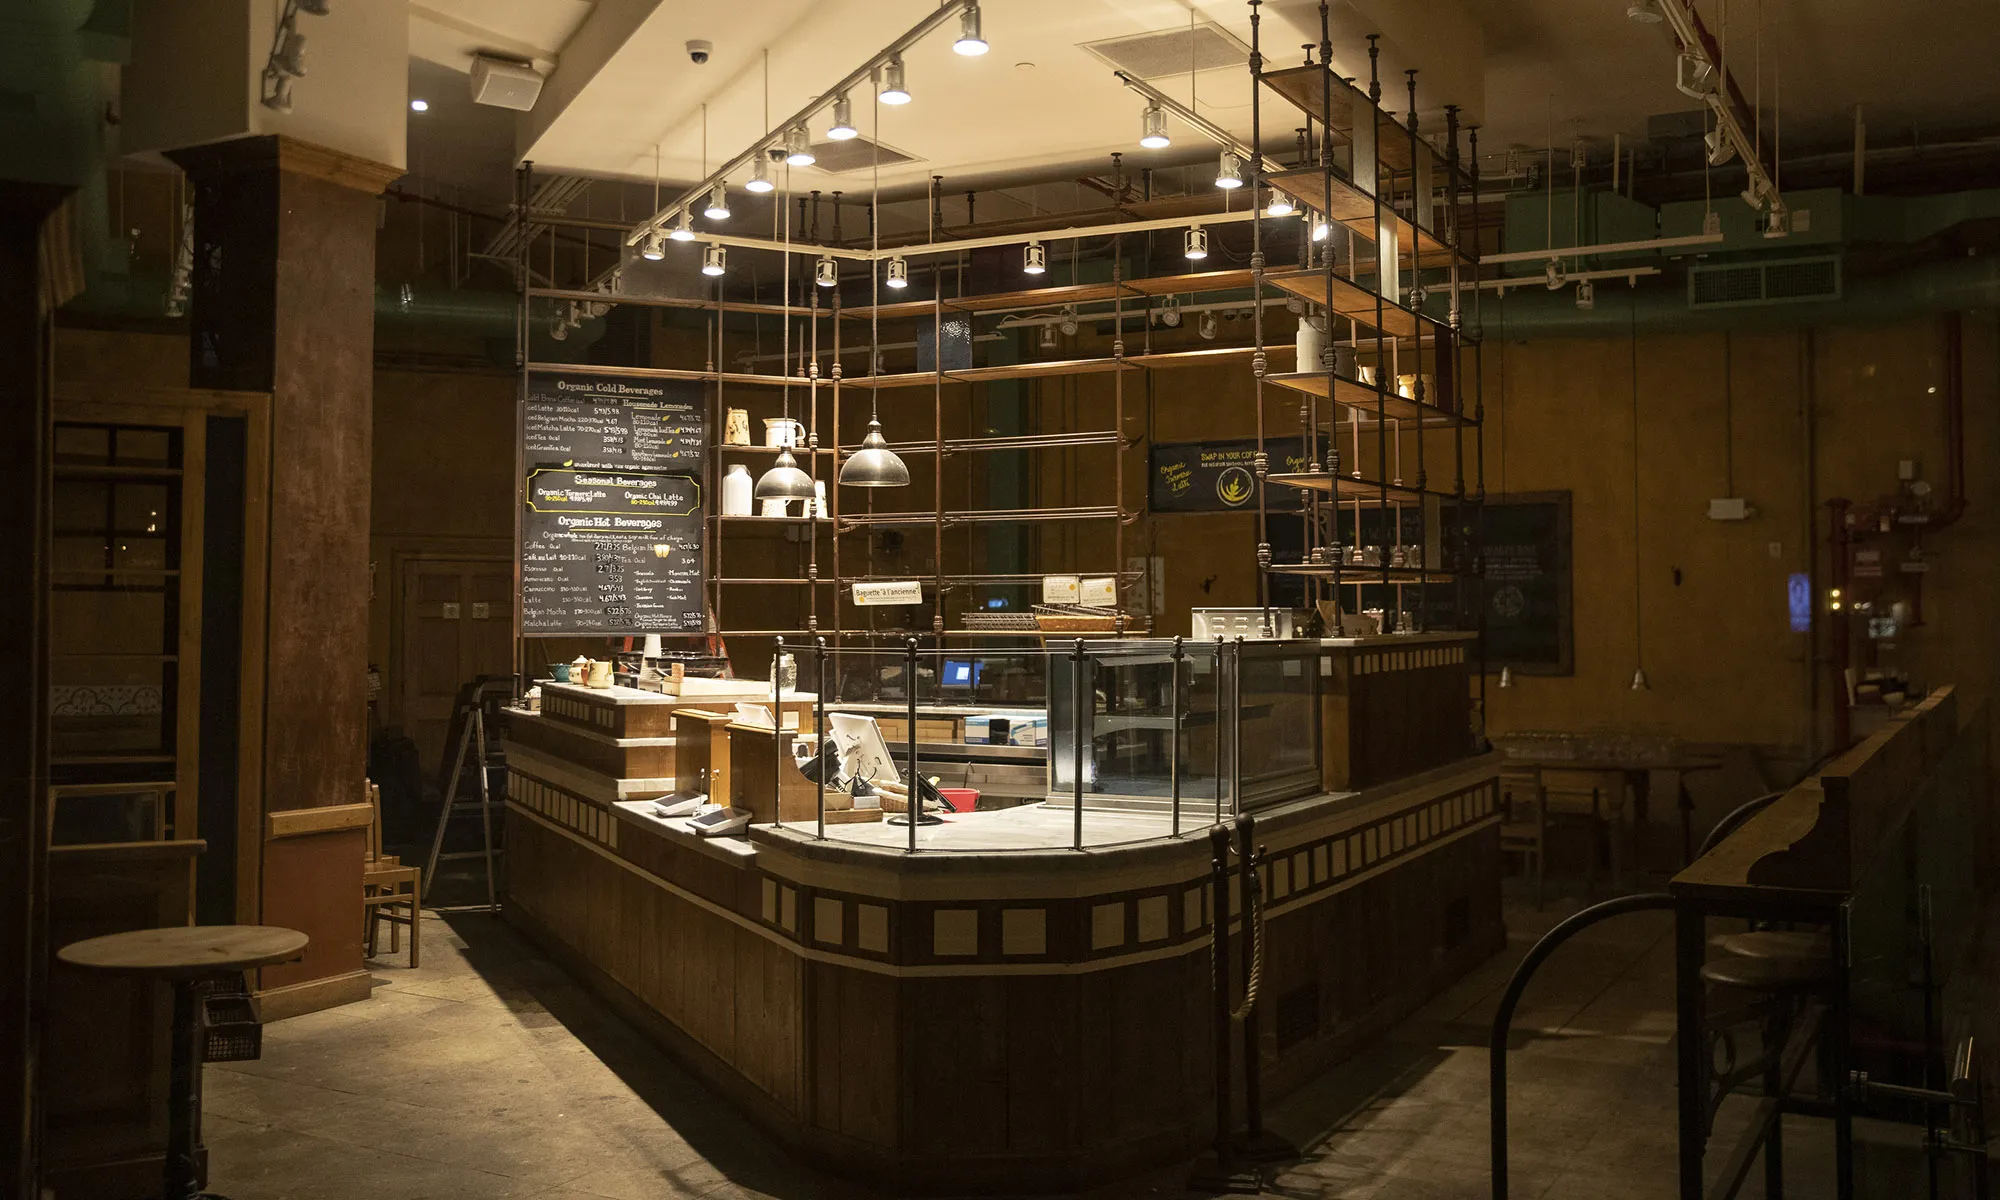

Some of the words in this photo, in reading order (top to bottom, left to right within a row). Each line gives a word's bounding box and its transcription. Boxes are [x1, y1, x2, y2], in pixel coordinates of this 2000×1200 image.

[558, 380, 594, 392] Organic
[596, 383, 616, 393] Cold
[618, 384, 664, 396] Beverages
[1201, 452, 1218, 460] SWAP
[1218, 452, 1224, 460] IN
[1225, 452, 1240, 460] YOUR
[574, 474, 614, 485] Seasonal
[616, 476, 658, 488] Beverages
[538, 488, 564, 496] Organic
[624, 491, 648, 500] Organic
[648, 492, 662, 500] Chai
[664, 493, 684, 501] Latte
[558, 516, 594, 528] Organic
[594, 517, 611, 527] Hot
[614, 517, 662, 530] Beverages
[524, 541, 546, 550] Coffee
[622, 544, 646, 554] Belgian
[620, 556, 632, 564] Tea
[524, 564, 547, 573] Espresso
[856, 589, 880, 597] Baguette
[524, 596, 542, 604] Latte
[524, 608, 545, 618] Belgian
